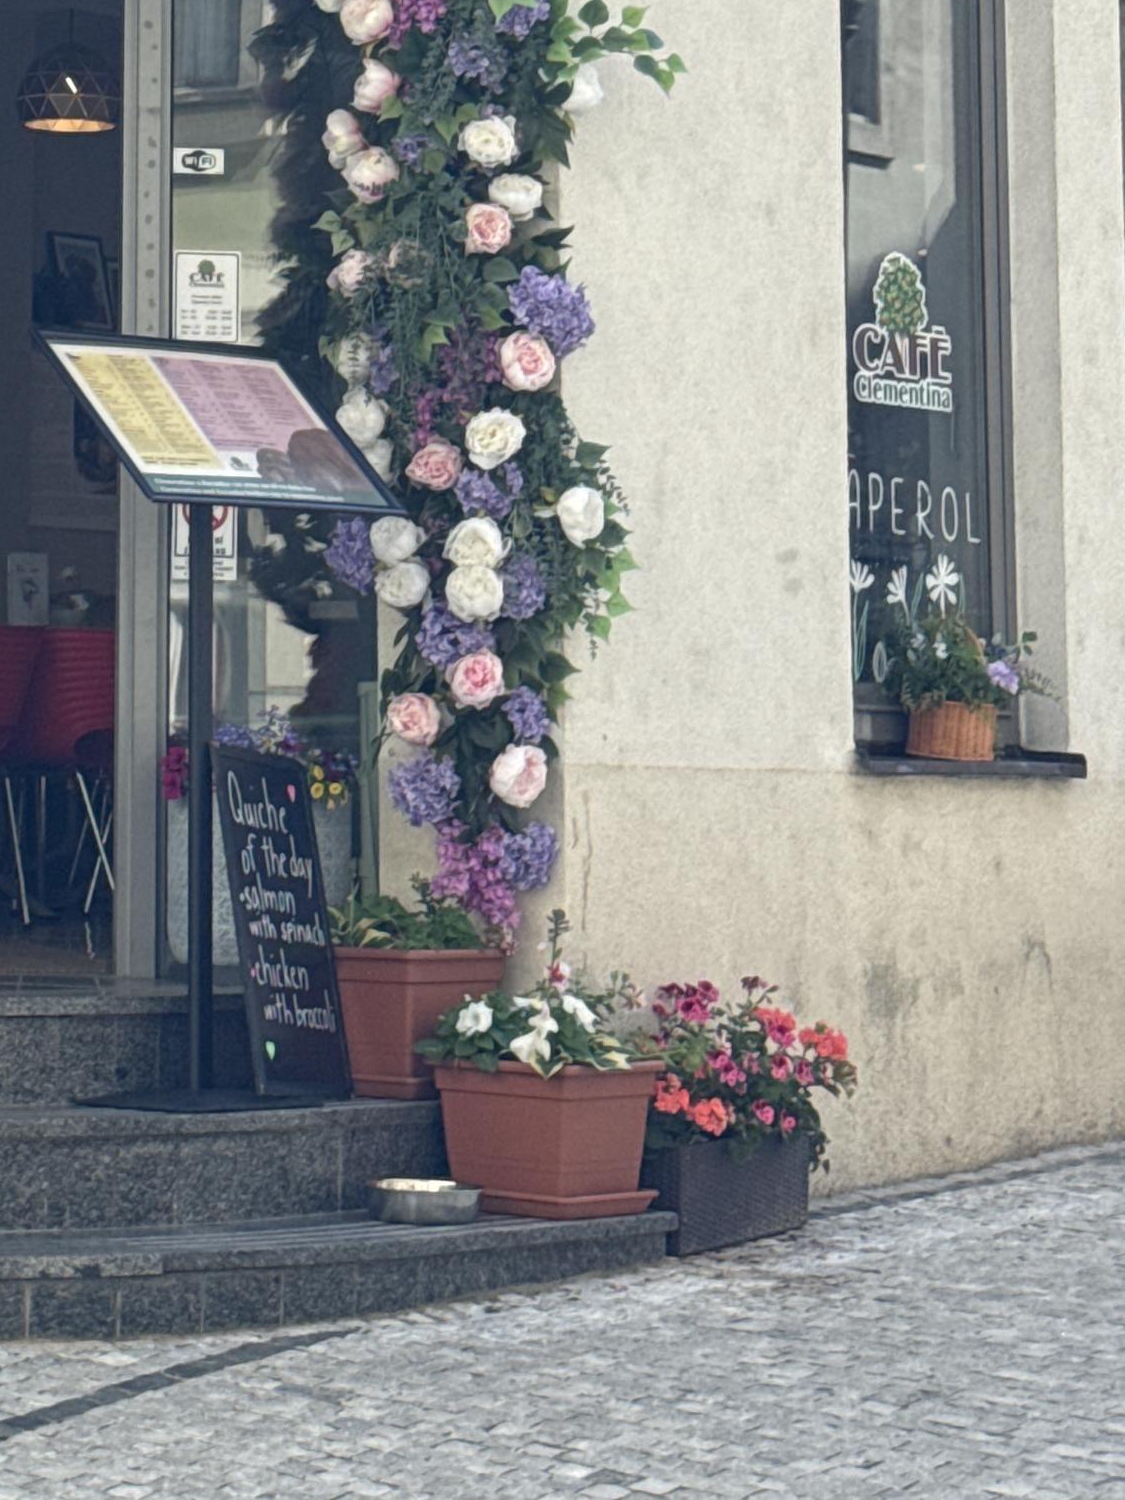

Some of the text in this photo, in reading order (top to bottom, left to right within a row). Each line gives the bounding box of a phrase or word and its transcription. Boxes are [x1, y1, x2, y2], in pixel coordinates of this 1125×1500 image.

[853, 324, 952, 382] CAFÉ
[848, 467, 982, 544] APEROL
[227, 770, 289, 835] Quiche
[241, 833, 313, 900] of the day
[243, 872, 297, 916] salmon
[248, 911, 326, 947] with spinach
[254, 943, 310, 992] chicken
[263, 989, 337, 1034] with broccoli
